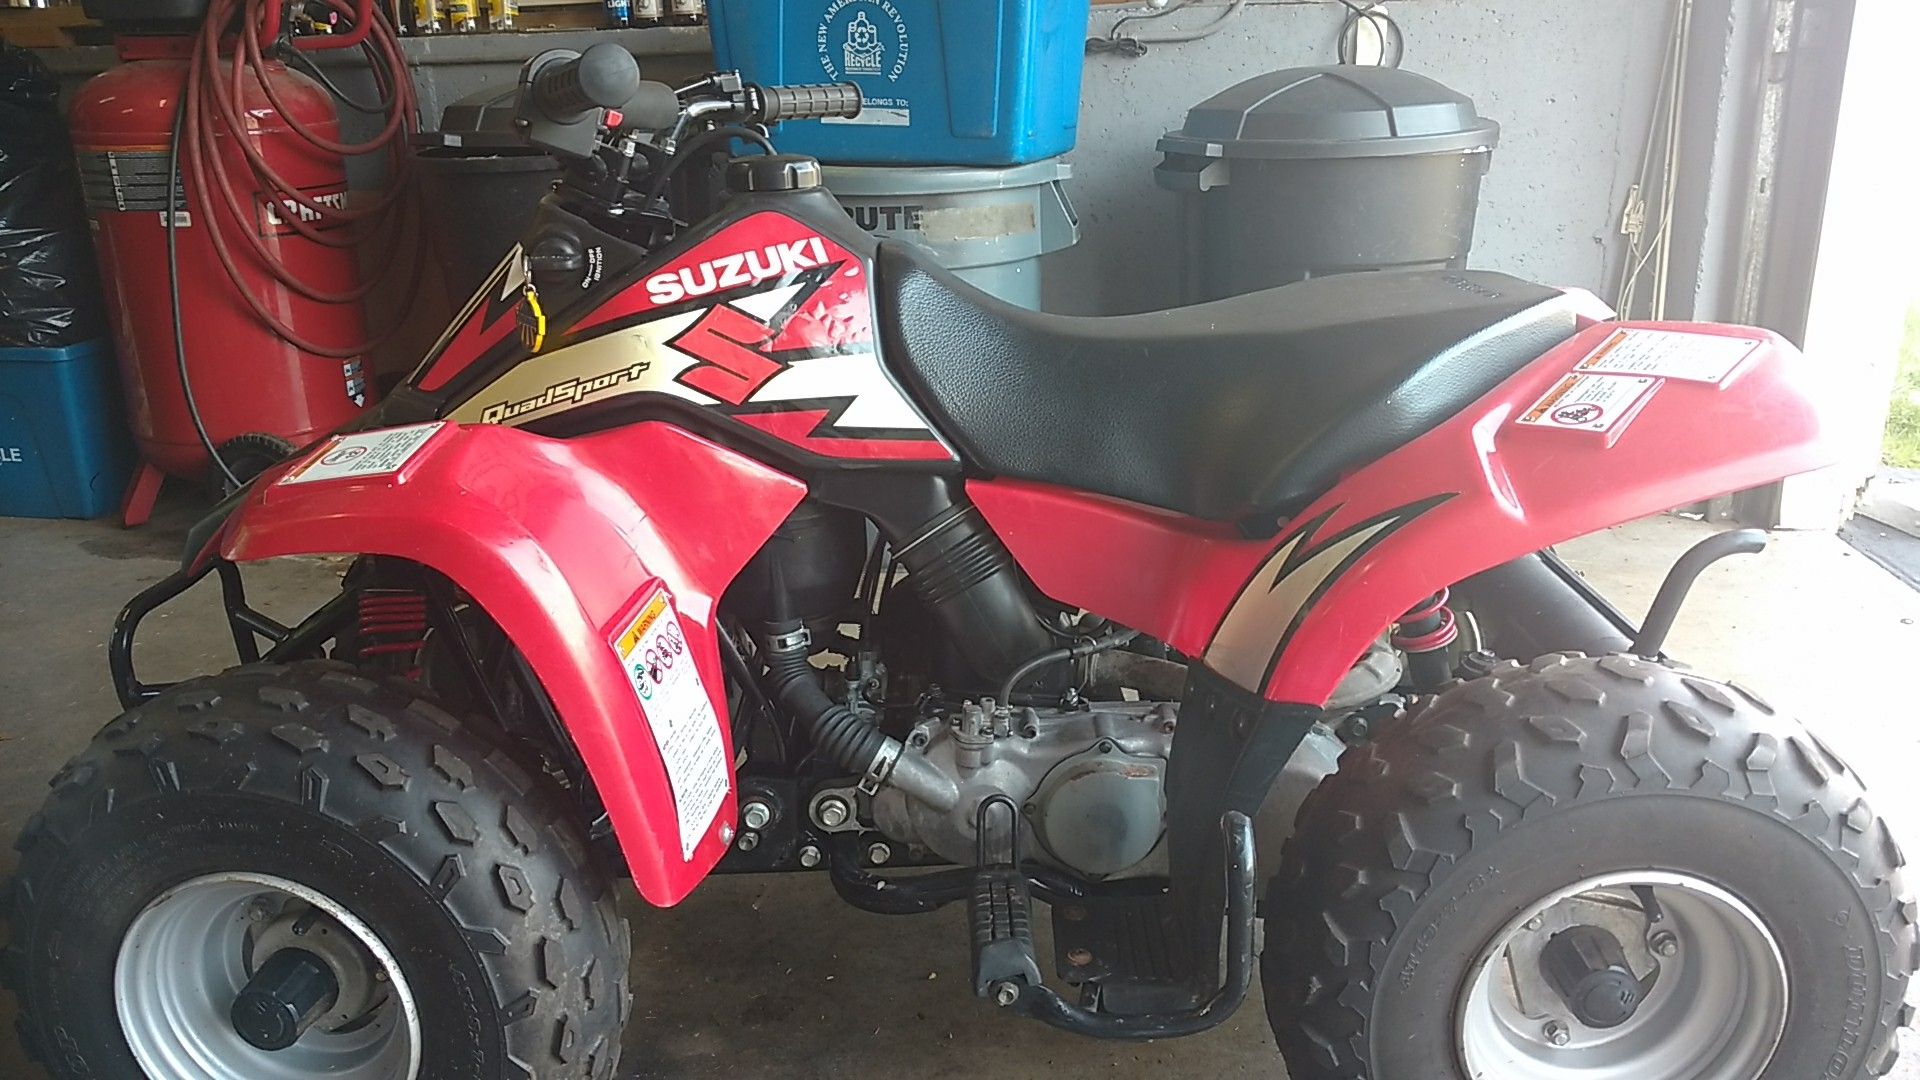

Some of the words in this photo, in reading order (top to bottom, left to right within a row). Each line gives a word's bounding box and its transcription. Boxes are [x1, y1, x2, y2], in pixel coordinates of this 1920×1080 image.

[824, 0, 880, 23] AMERN
[818, 23, 828, 53] NEW
[881, 1, 909, 82] REVOLUTION
[820, 55, 839, 81] THE
[845, 50, 881, 67] RECYCLE
[895, 99, 909, 107] TO:
[594, 246, 603, 281] IGNITION
[646, 237, 830, 304] SUZUKI
[481, 361, 651, 424] QuadSport
